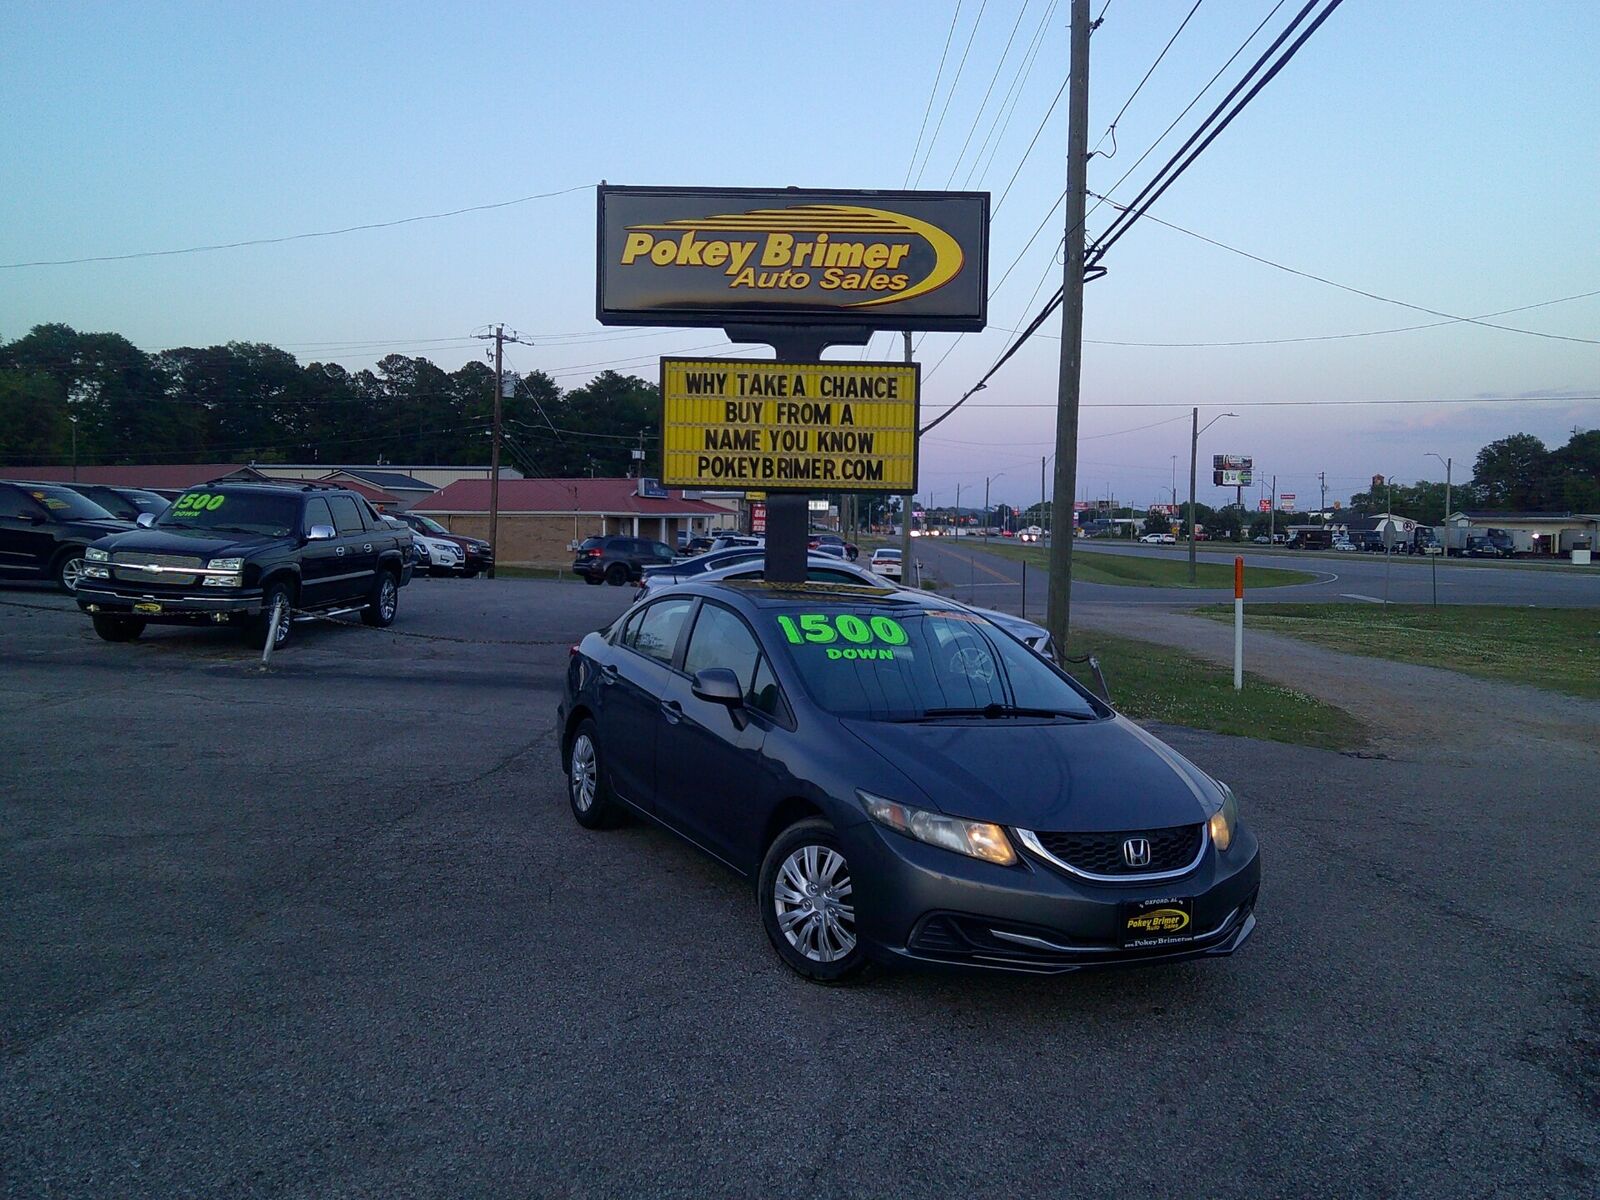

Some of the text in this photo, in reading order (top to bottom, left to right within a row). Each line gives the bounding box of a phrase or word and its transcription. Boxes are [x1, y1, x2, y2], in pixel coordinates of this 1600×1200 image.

[621, 229, 910, 274] Pokey Brimer
[730, 268, 910, 290] Auto Sales
[685, 373, 898, 399] WHY TAKE A CHANCE
[725, 401, 854, 426] BUY FROM A
[704, 429, 874, 454] NAME YOU KNOW
[697, 456, 884, 481] POKEYBRIMER.COM
[172, 493, 225, 511] 1500
[777, 614, 909, 645] 1500
[826, 648, 894, 660] DOWN
[1127, 916, 1179, 928] Pokey Brimer
